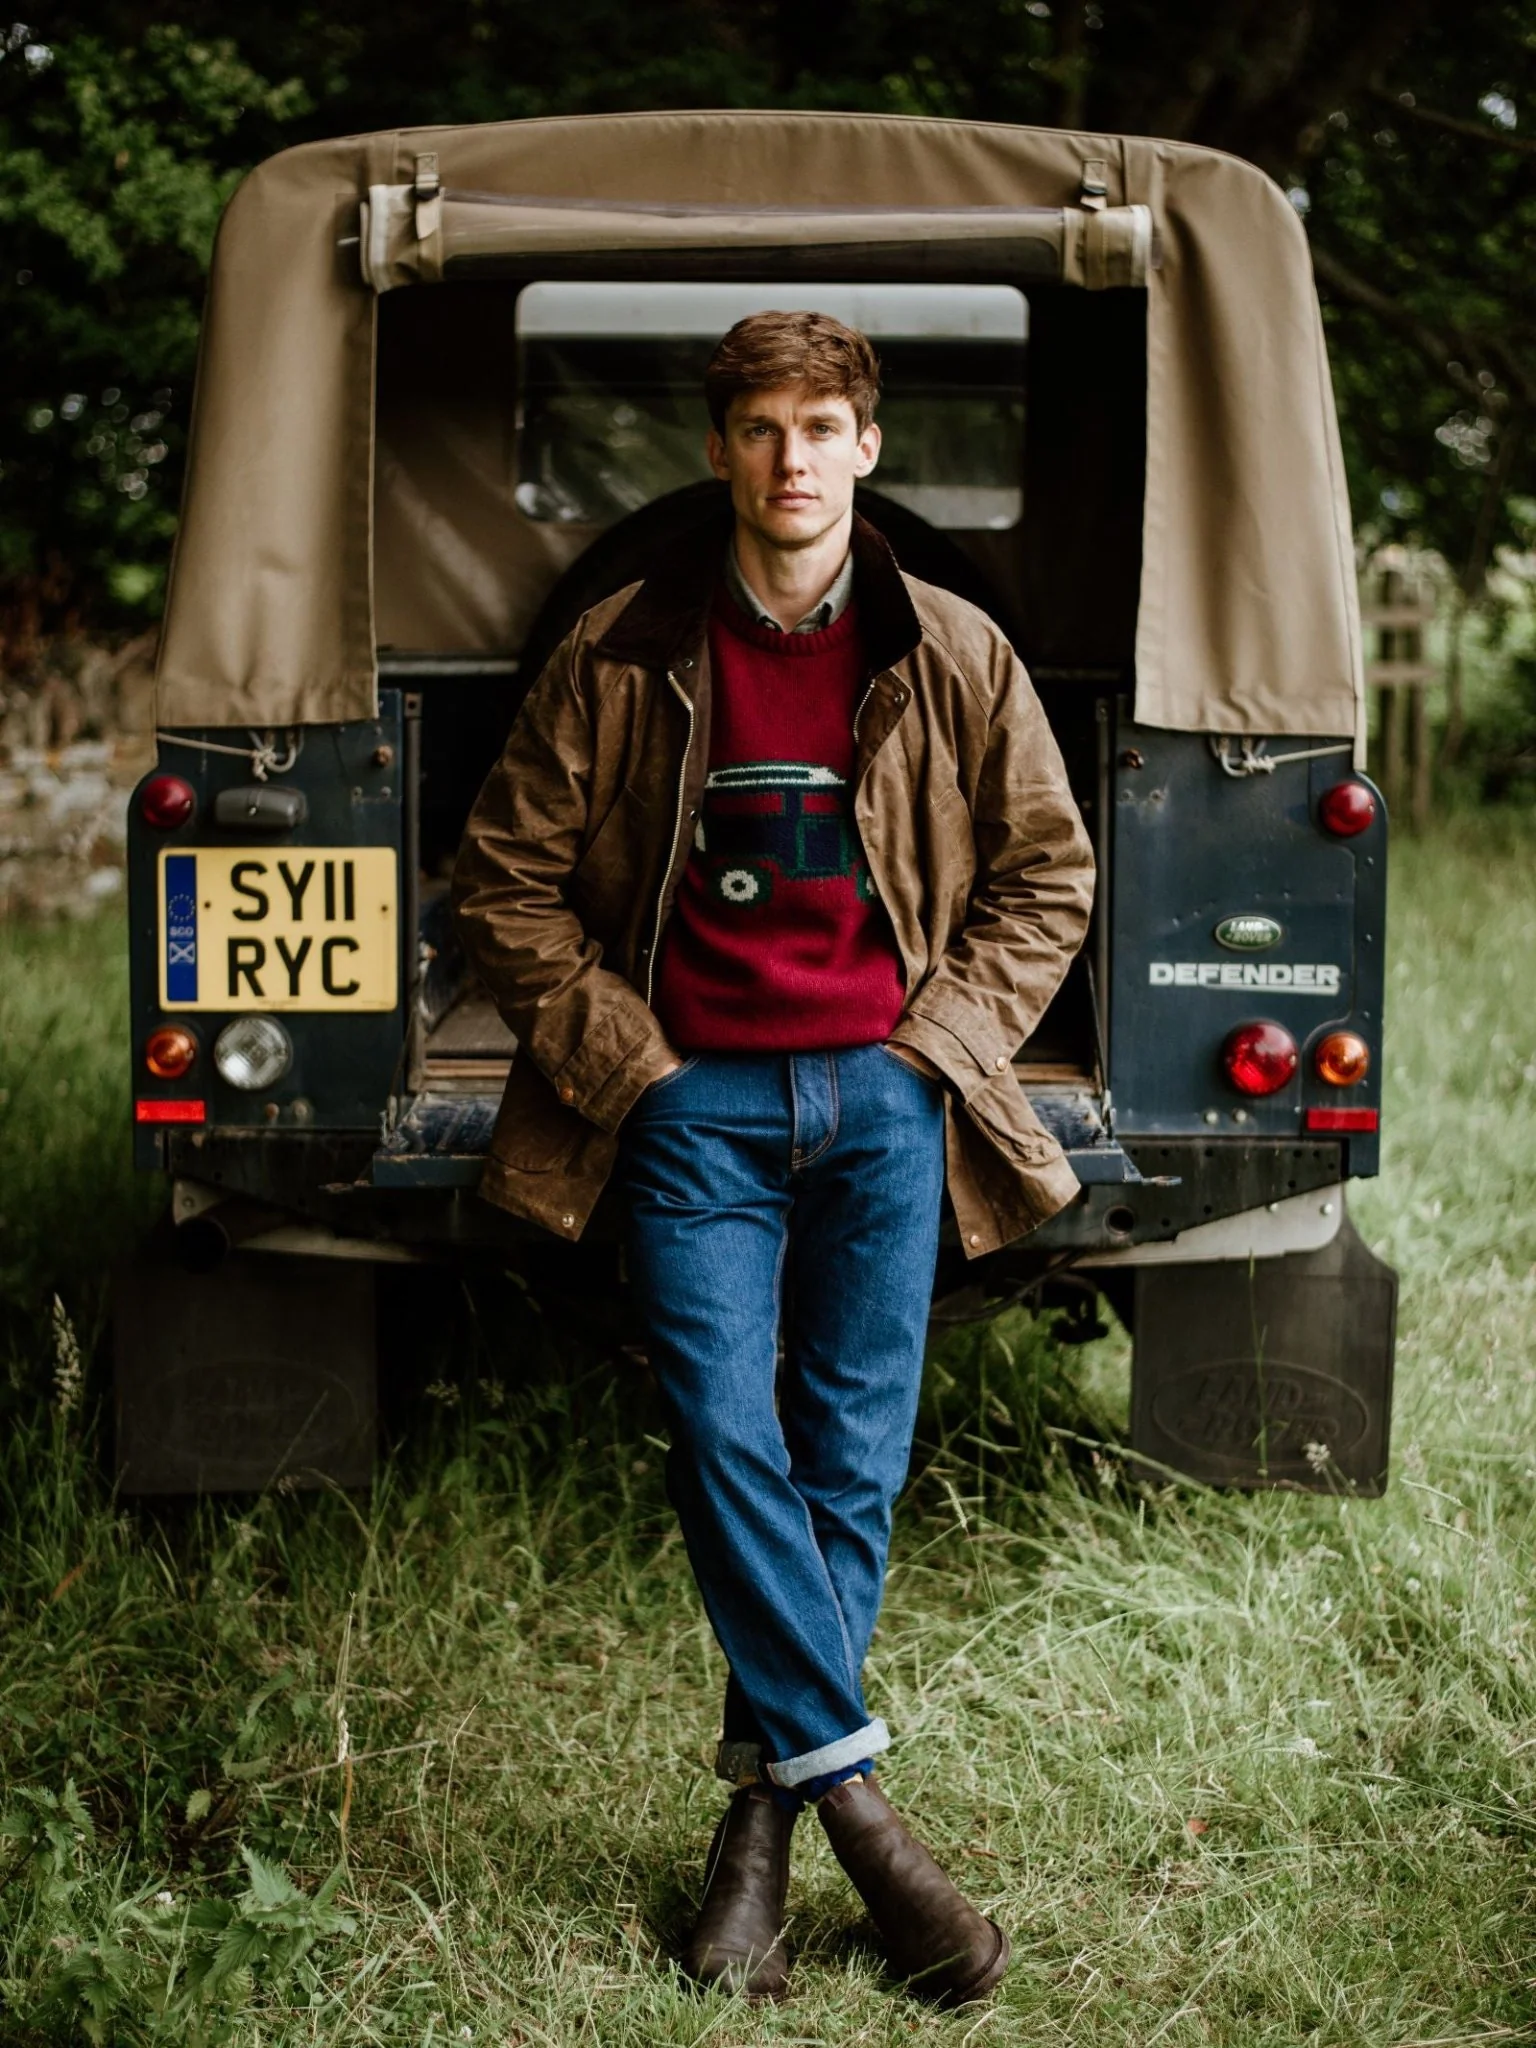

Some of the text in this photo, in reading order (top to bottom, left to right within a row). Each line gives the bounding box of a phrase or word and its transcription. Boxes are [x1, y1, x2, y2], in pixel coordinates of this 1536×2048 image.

[230, 860, 356, 922] SY11
[227, 936, 361, 997] RYC
[1149, 962, 1341, 986] DEFENDER
